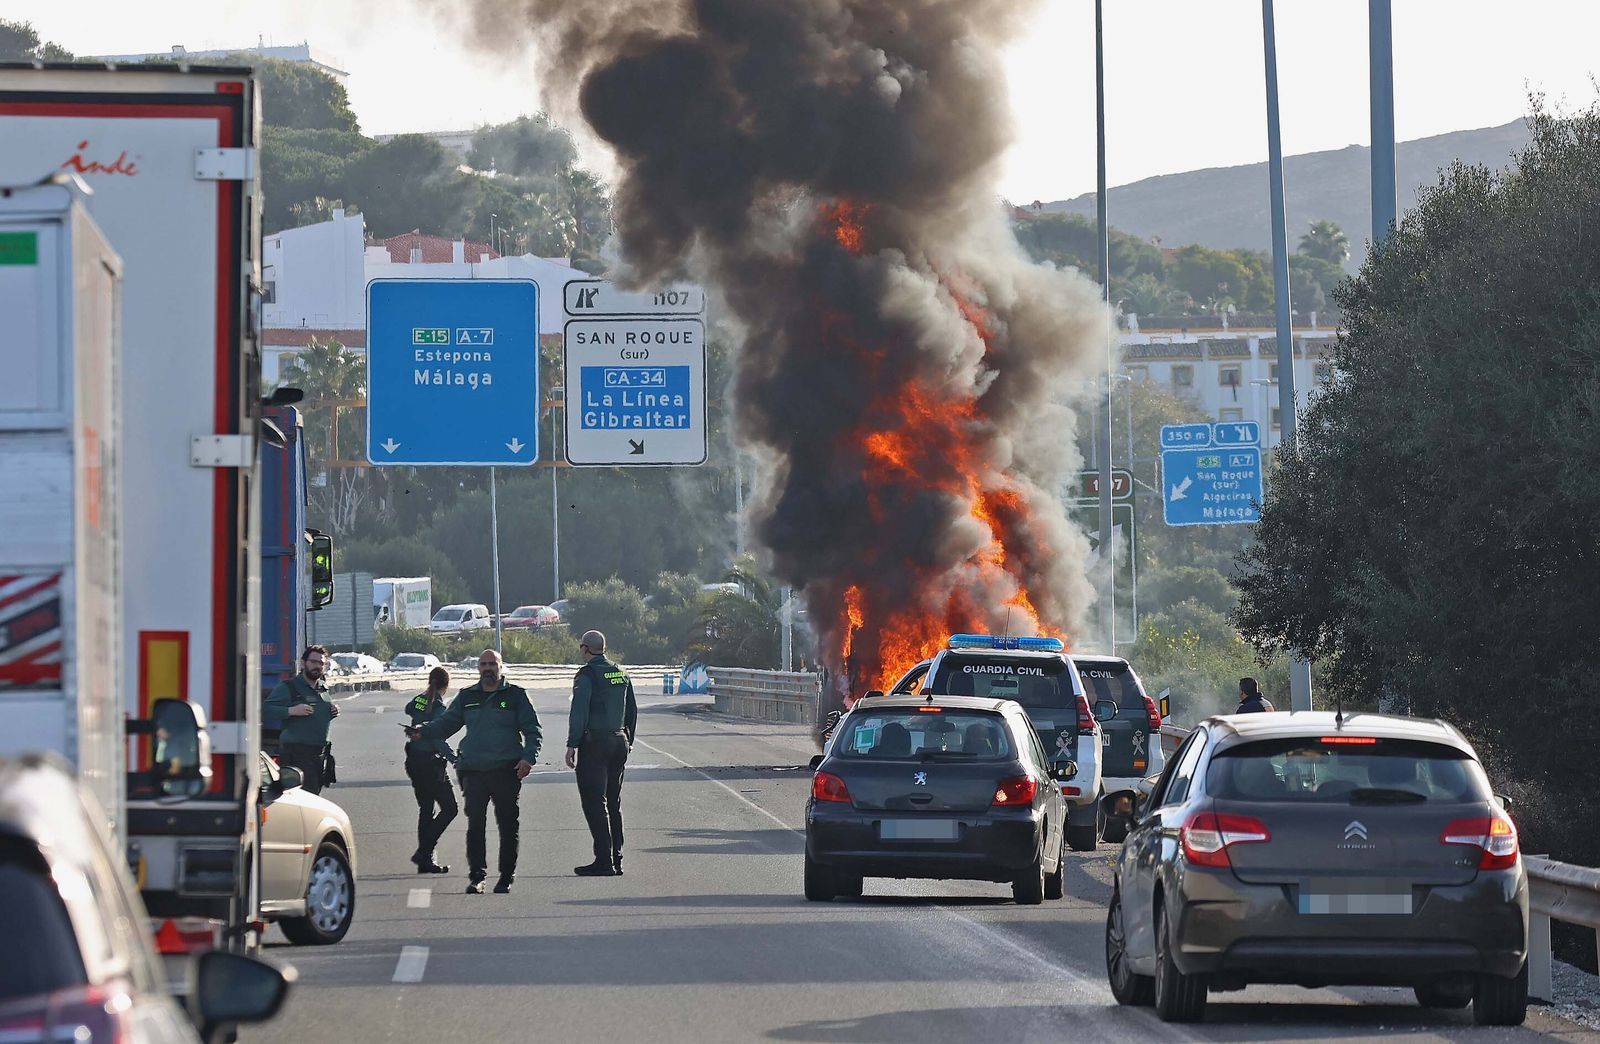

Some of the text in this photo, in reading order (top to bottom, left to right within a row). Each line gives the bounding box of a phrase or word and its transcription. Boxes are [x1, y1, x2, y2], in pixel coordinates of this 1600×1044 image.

[415, 330, 491, 342] E-15 A-7
[577, 332, 693, 344] SAN ROQUE
[415, 349, 491, 365] Estepona
[620, 348, 649, 360] (sur)
[414, 369, 492, 390] Málaga
[606, 371, 663, 385] CA-34
[587, 391, 684, 407] La Línea
[584, 411, 687, 428] Gibraltar
[1232, 455, 1251, 465] A-7
[1197, 471, 1254, 480] San Roque
[1093, 479, 1123, 491] 17
[963, 665, 1045, 676] GUARDIA CIVIL
[1090, 670, 1114, 679] CIVIL
